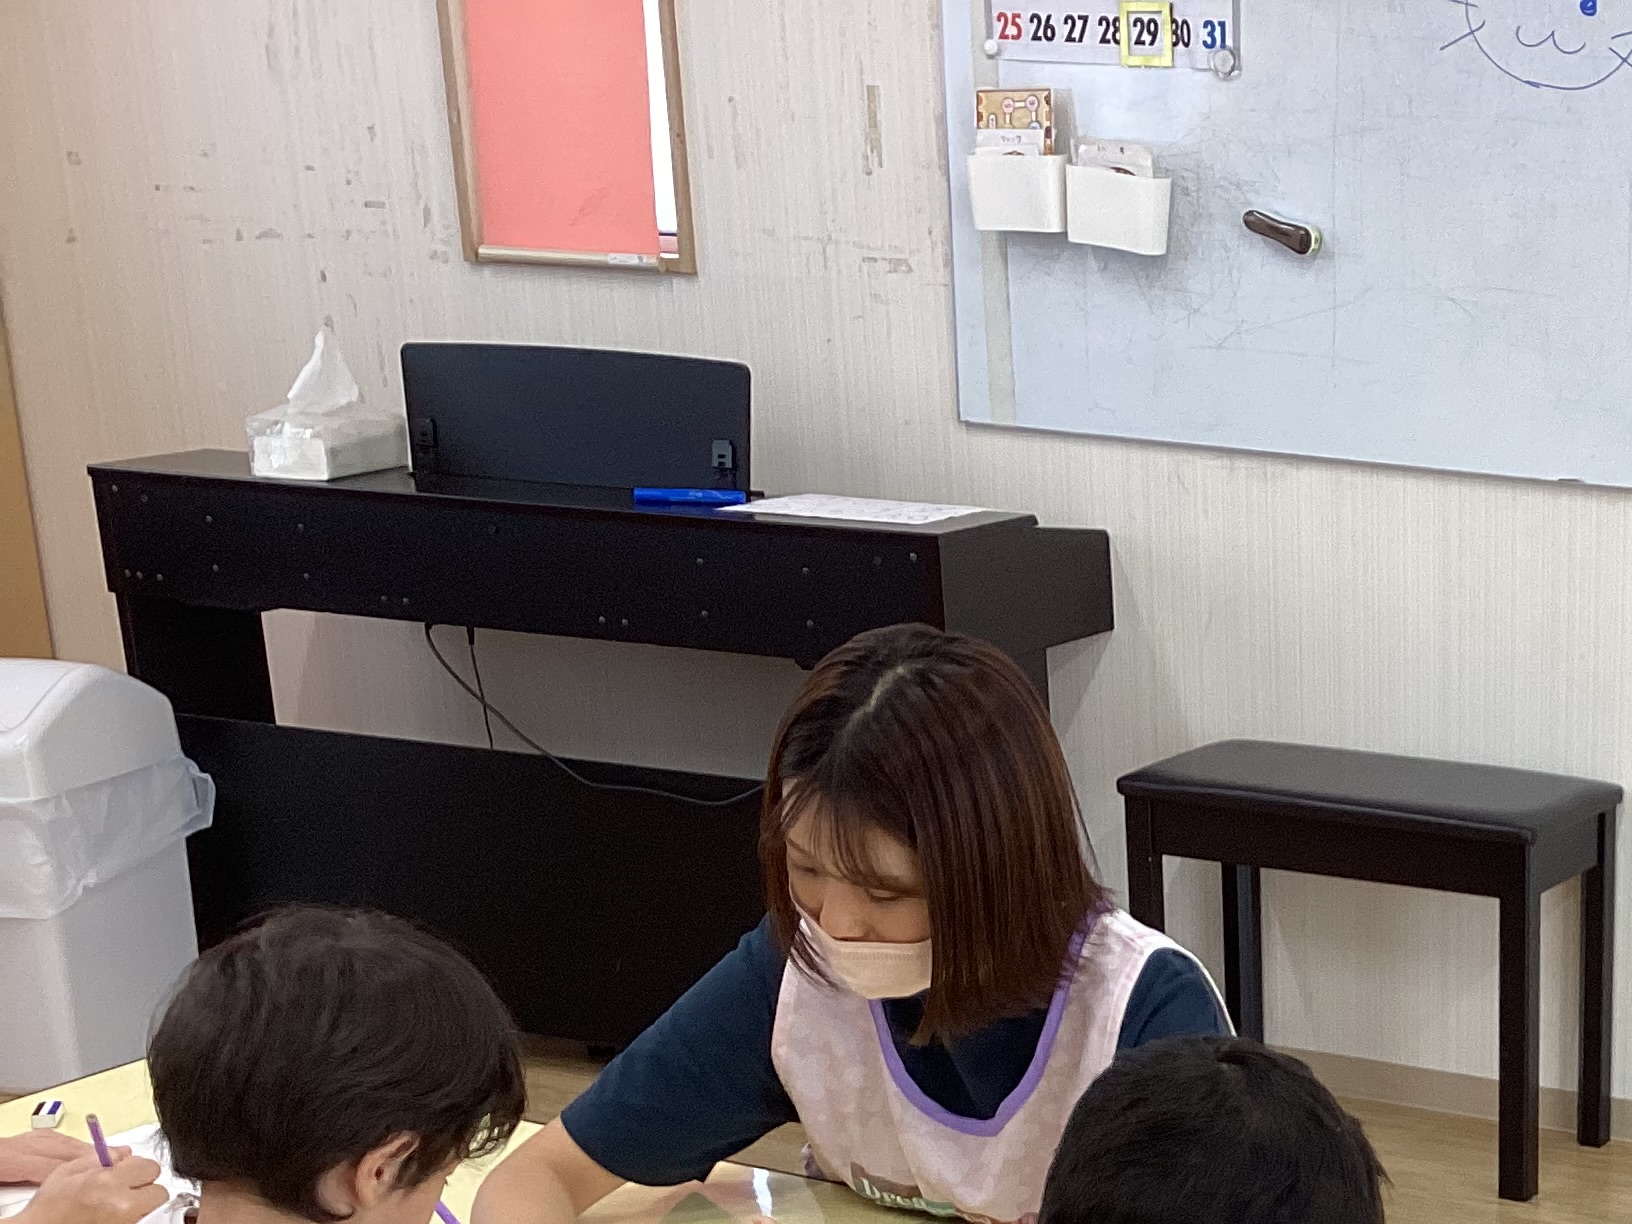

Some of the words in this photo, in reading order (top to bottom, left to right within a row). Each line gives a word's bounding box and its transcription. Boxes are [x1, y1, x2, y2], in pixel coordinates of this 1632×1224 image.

[997, 12, 1023, 41] 25
[1029, 13, 1056, 42] 26
[1063, 14, 1089, 44] 27
[1097, 15, 1121, 46] 28
[1132, 16, 1159, 47] 29
[1202, 20, 1227, 50] 31
